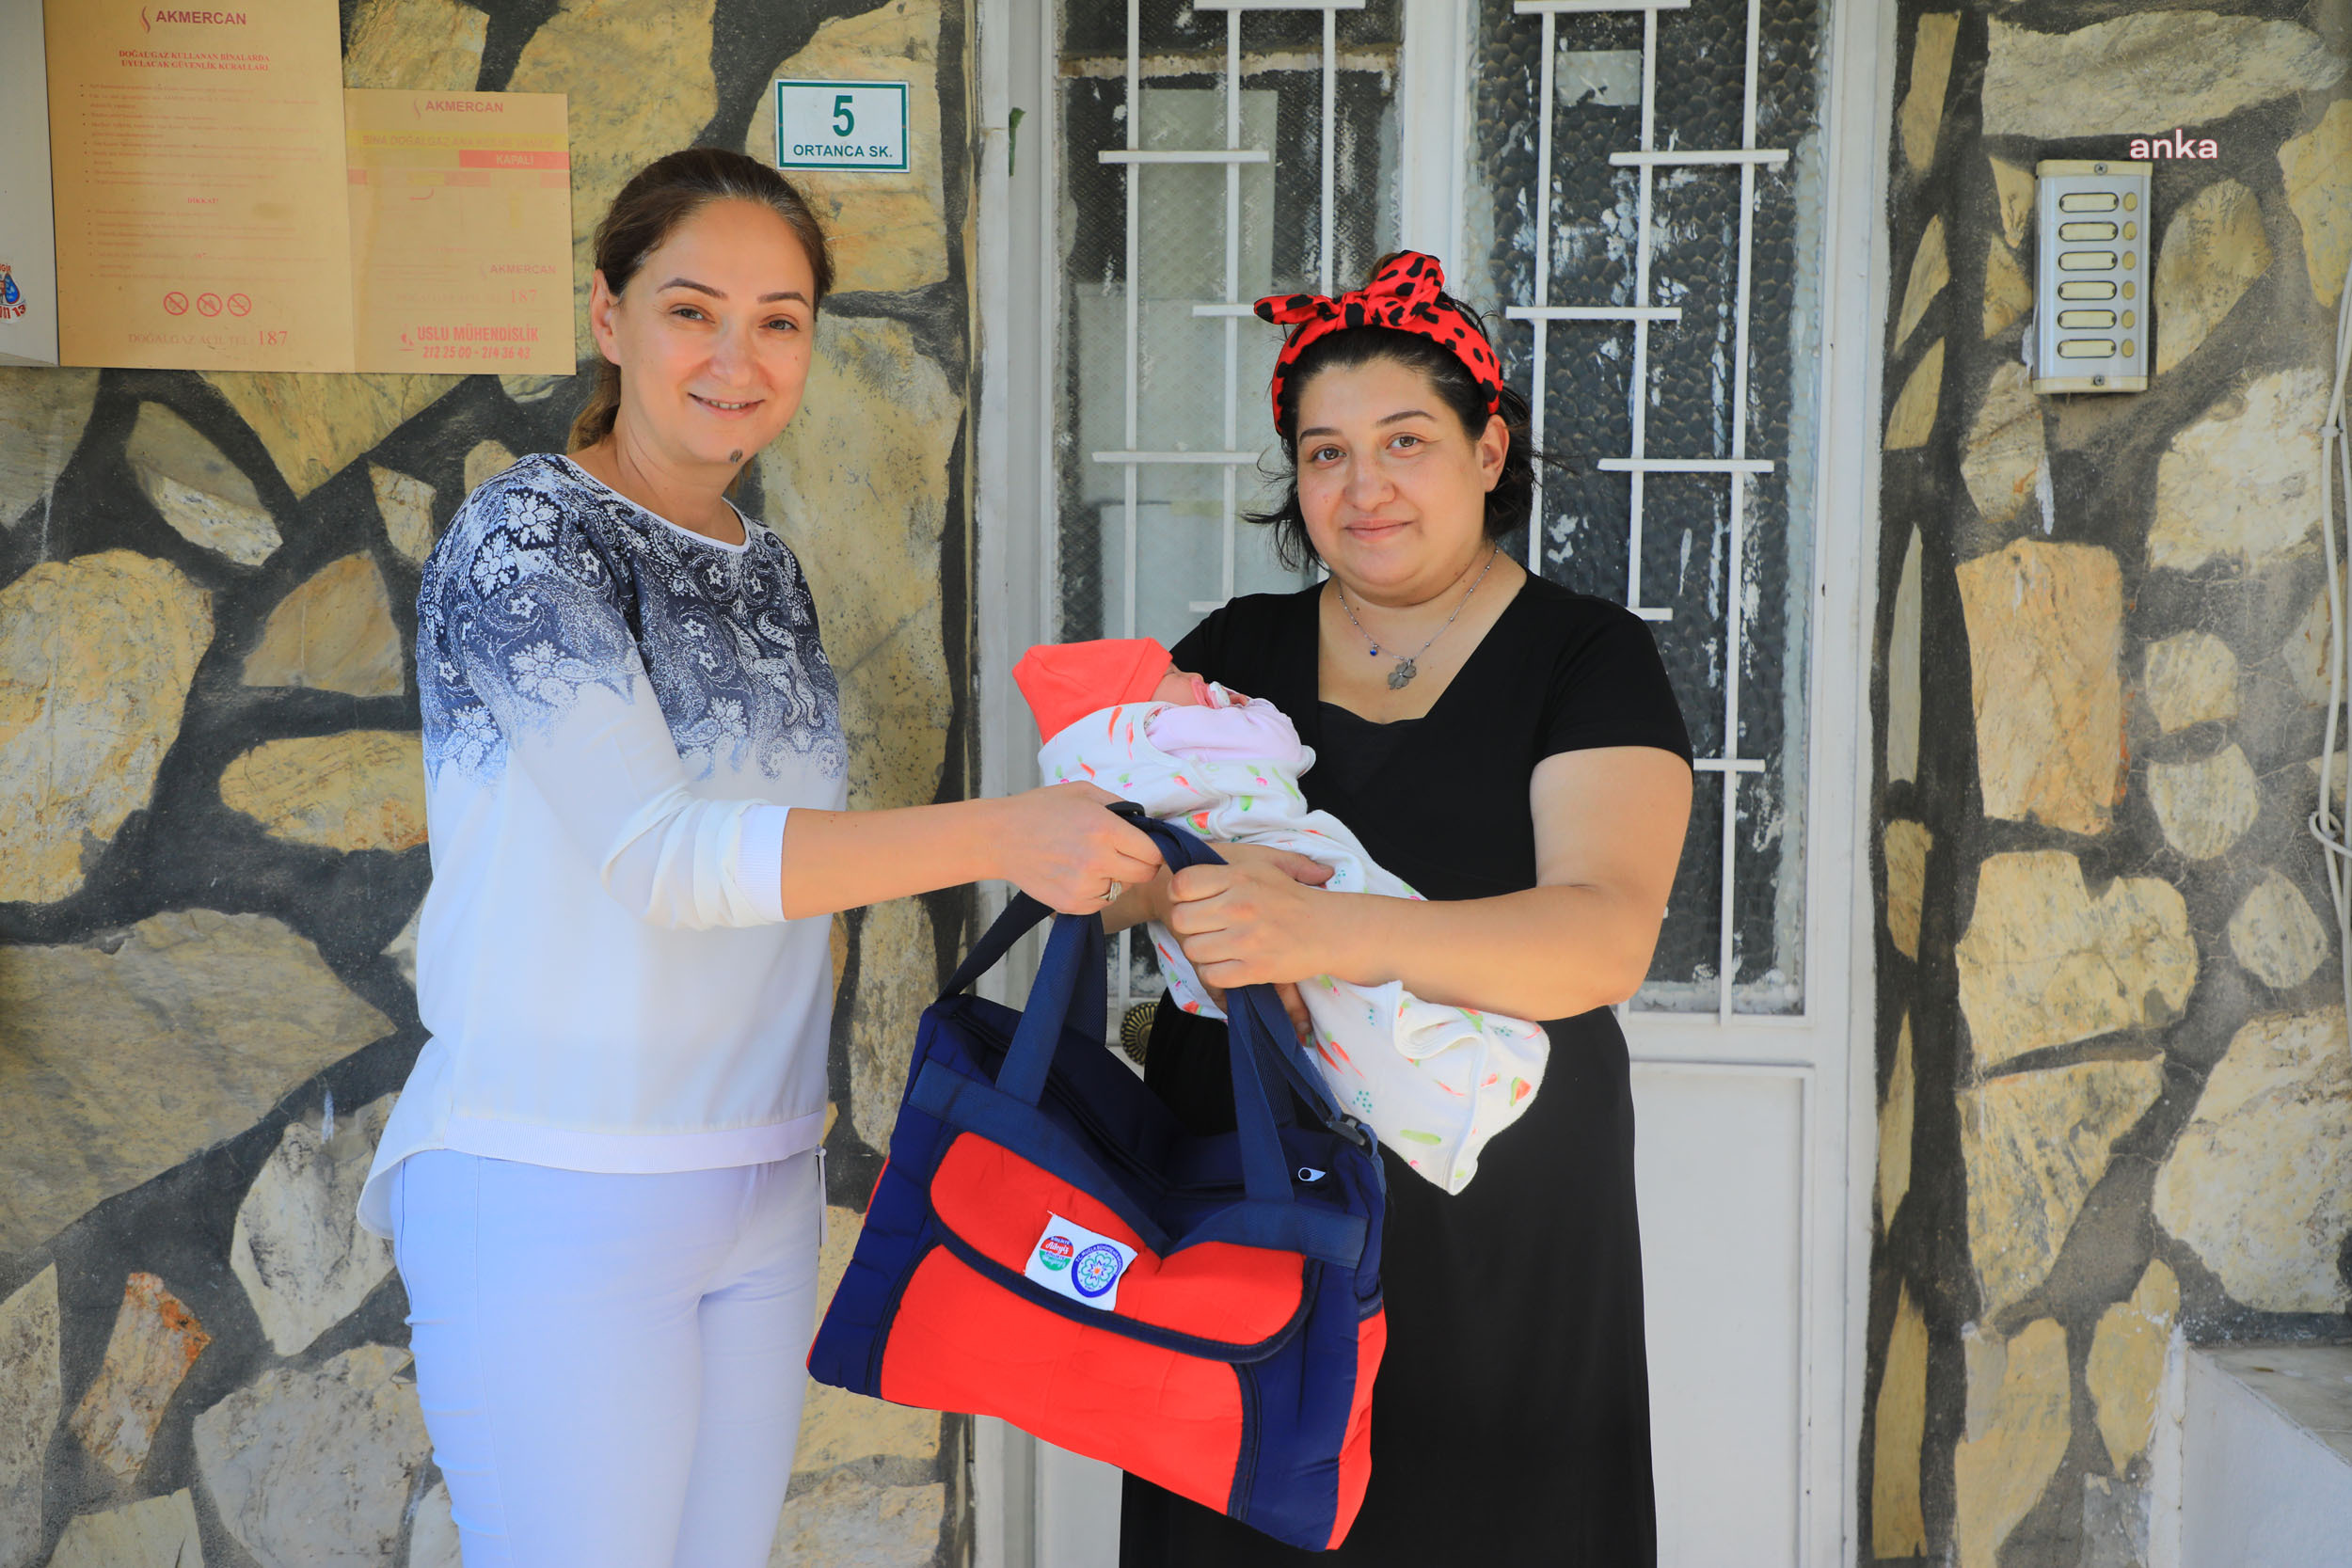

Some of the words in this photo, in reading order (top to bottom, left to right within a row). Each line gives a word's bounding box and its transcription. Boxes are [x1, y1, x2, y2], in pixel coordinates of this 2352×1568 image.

[156, 9, 246, 25] AKMERCAN
[425, 100, 504, 114] AKMERCAN
[833, 95, 855, 137] 5
[496, 153, 534, 166] KAPALI
[793, 145, 865, 157] ORTANCA
[869, 146, 893, 158] SK.
[511, 288, 537, 304] 187
[259, 330, 288, 346] 187
[417, 325, 450, 341] USLU
[453, 323, 540, 341] MÜHENDİSLİK
[422, 345, 440, 359] 212
[442, 345, 456, 359] 25
